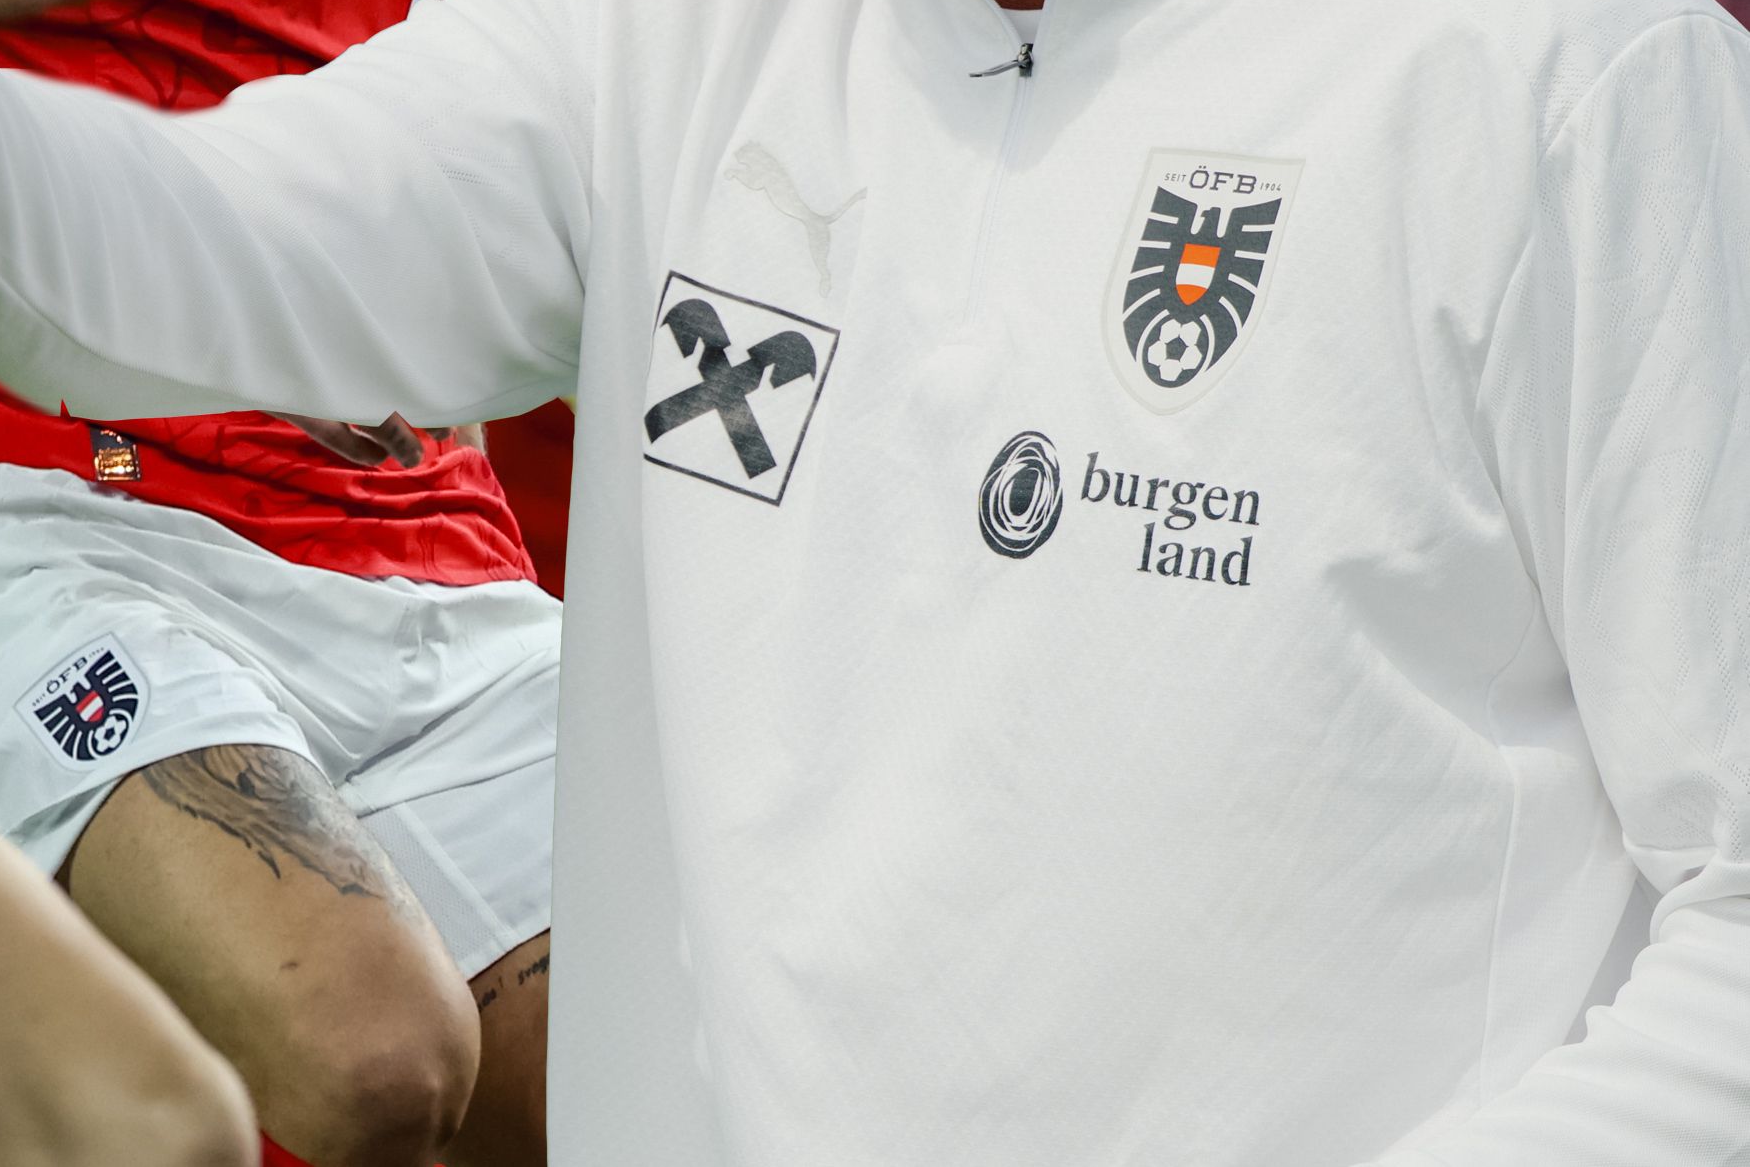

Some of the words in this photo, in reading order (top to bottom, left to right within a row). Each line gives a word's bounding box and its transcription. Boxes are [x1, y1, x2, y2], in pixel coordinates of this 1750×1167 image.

[1164, 172, 1187, 183] SEIT
[1189, 165, 1257, 195] ÖFB
[1259, 182, 1282, 192] 1904
[1080, 450, 1260, 531] burgen
[1136, 521, 1253, 587] land
[46, 656, 88, 695] ÖFB
